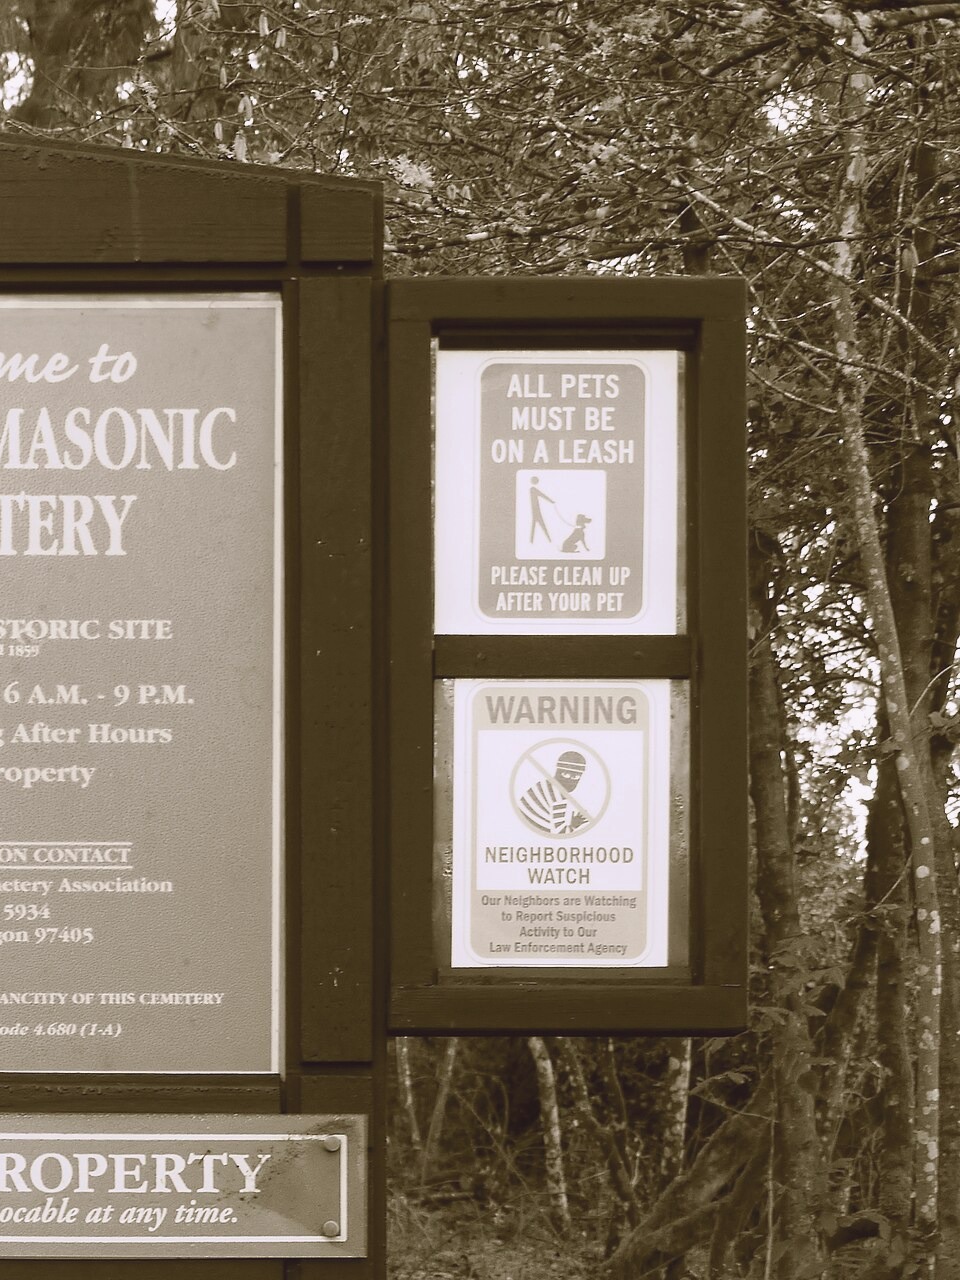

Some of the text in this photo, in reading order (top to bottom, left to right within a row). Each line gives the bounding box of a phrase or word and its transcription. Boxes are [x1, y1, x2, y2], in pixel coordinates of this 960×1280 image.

[88, 343, 138, 384] to
[506, 373, 620, 399] ALL PETS
[511, 406, 616, 431] MUST BE
[491, 439, 635, 464] ON A LEASH
[490, 566, 631, 586] PLEASE CLEAN UP
[496, 592, 624, 612] AFTER YOUR PET
[108, 619, 174, 640] SITE
[8, 644, 40, 658] 1859
[3, 681, 20, 706] 6
[27, 684, 89, 706] A.M.
[113, 684, 131, 706] 9
[137, 685, 196, 706] P.M.
[485, 696, 637, 724] WARNING
[10, 722, 82, 744] After
[87, 723, 173, 745] Hours
[33, 847, 132, 864] CONTACT
[485, 847, 634, 863] NEIGHBORHOOD
[527, 868, 590, 884] WATCH
[57, 878, 174, 894] Association
[481, 895, 637, 909] Our Neighbors are Watching
[3, 904, 52, 921] 5934
[501, 911, 616, 925] to Report Suspicious
[34, 927, 94, 945] 97405
[519, 927, 597, 940] Activity to Our
[490, 942, 627, 956] Law Enforcement Agency
[72, 993, 94, 1005] OF
[98, 993, 136, 1005] THIS
[139, 993, 224, 1005] CEMETERY
[33, 1022, 76, 1036] 4.680
[85, 1204, 113, 1224] at
[119, 1206, 168, 1232] any
[174, 1200, 239, 1224] time.
